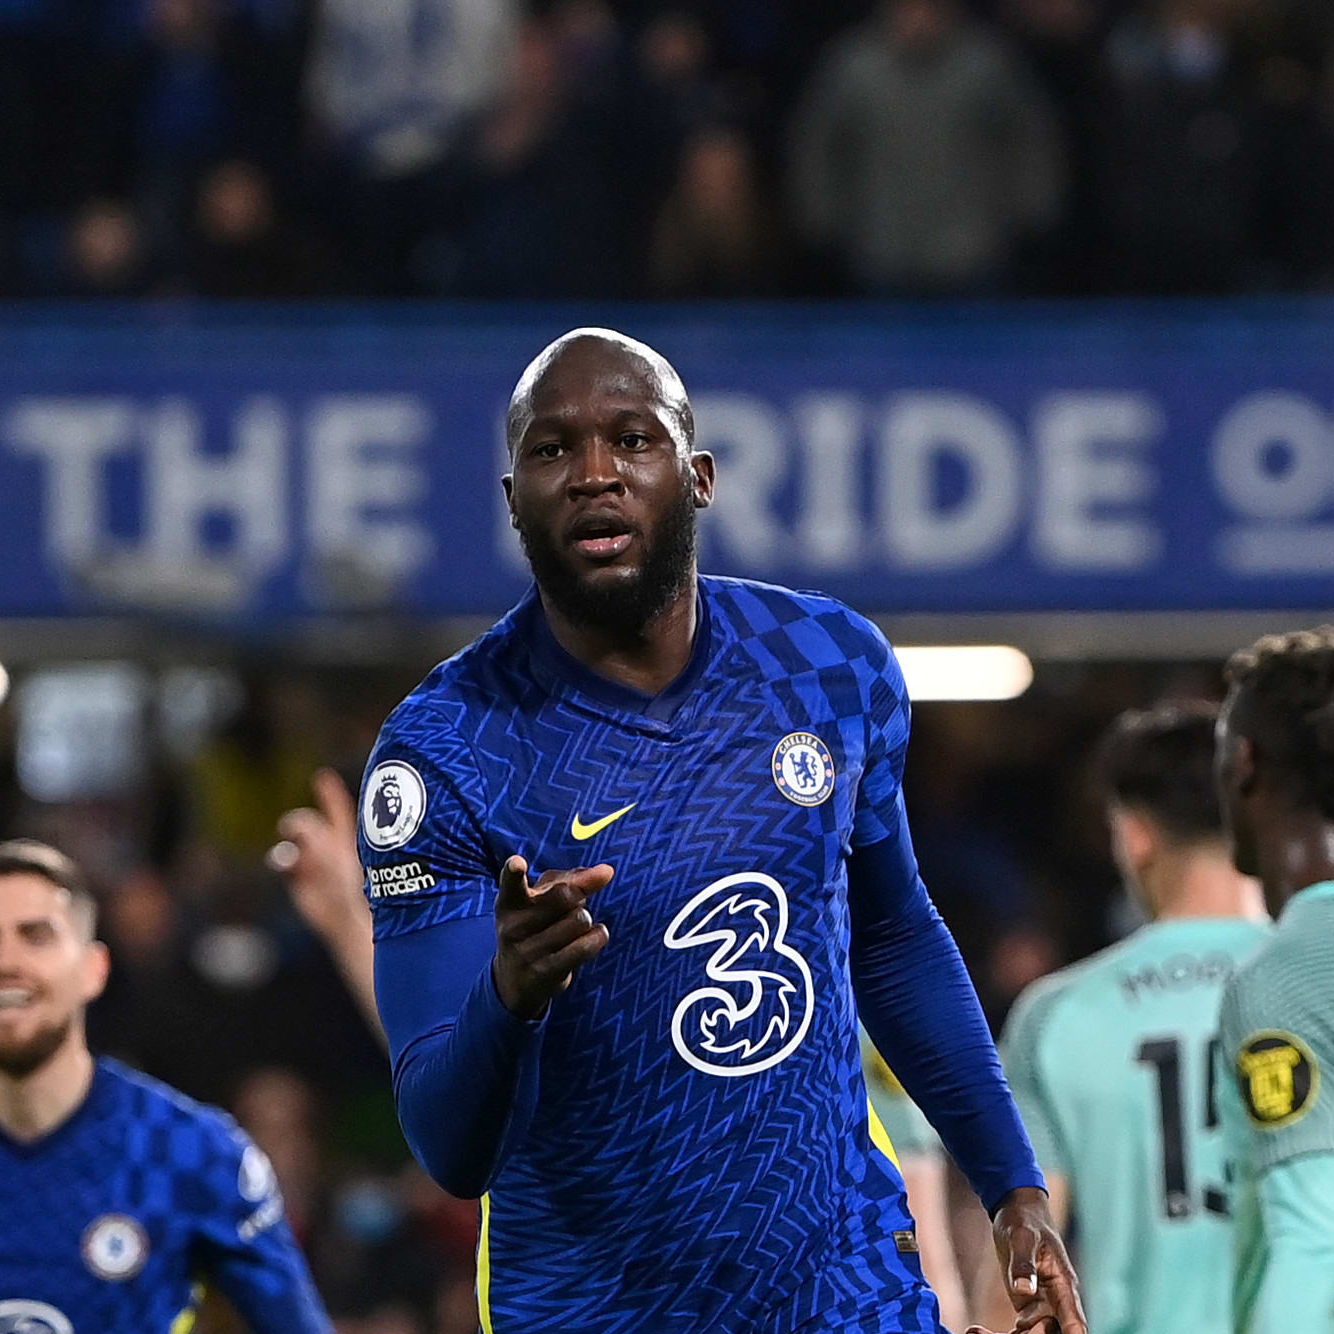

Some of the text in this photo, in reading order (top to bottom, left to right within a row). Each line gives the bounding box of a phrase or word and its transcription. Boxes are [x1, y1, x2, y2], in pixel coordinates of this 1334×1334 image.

[2, 398, 432, 575] THE
[507, 392, 1159, 574] RIDE
[779, 735, 819, 755] CHELSEA
[380, 861, 422, 883] room
[383, 873, 436, 897] racism
